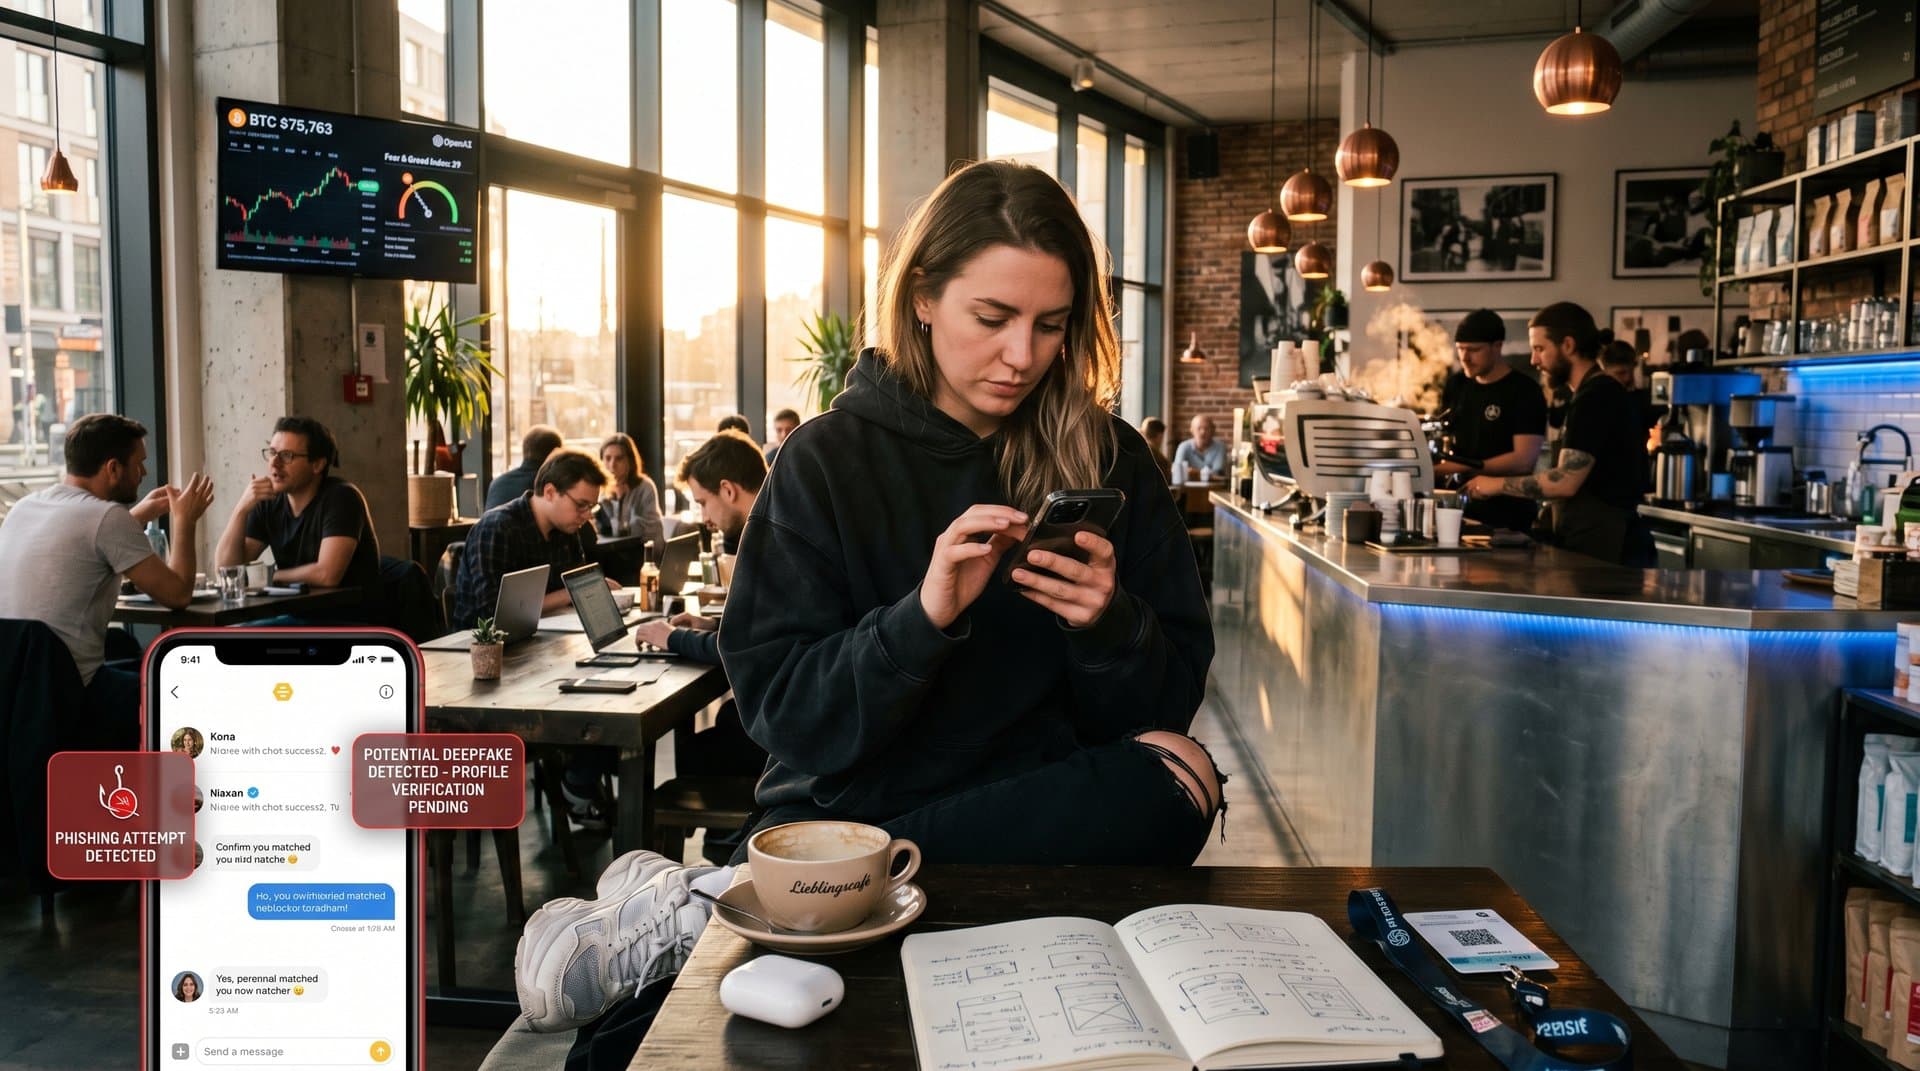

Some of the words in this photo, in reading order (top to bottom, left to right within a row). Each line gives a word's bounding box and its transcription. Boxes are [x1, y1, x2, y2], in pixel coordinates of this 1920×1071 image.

[249, 113, 277, 129] BTC
[279, 119, 334, 136] $75,763
[443, 138, 473, 150] OpenAI
[180, 655, 201, 665] 9:41
[210, 732, 236, 742] Kona
[241, 746, 261, 755] with
[261, 746, 283, 755] chot
[210, 788, 244, 798] Niaxan
[241, 802, 261, 812] with
[215, 842, 251, 852] Confirm
[252, 844, 270, 854] you
[271, 842, 311, 852] matched
[215, 856, 233, 866] you
[254, 855, 286, 864] natche
[789, 872, 872, 898] Lieblingscafé
[273, 892, 291, 903] you
[345, 890, 386, 901] matched
[215, 974, 235, 985] Yes,
[278, 974, 319, 984] matched
[215, 988, 233, 998] you
[234, 988, 254, 997] now
[255, 986, 291, 996] natcher
[208, 1007, 225, 1015] 5:23
[226, 1007, 239, 1015] AM
[204, 1047, 229, 1057] Send
[231, 1048, 238, 1057] a
[239, 1048, 284, 1060] message
